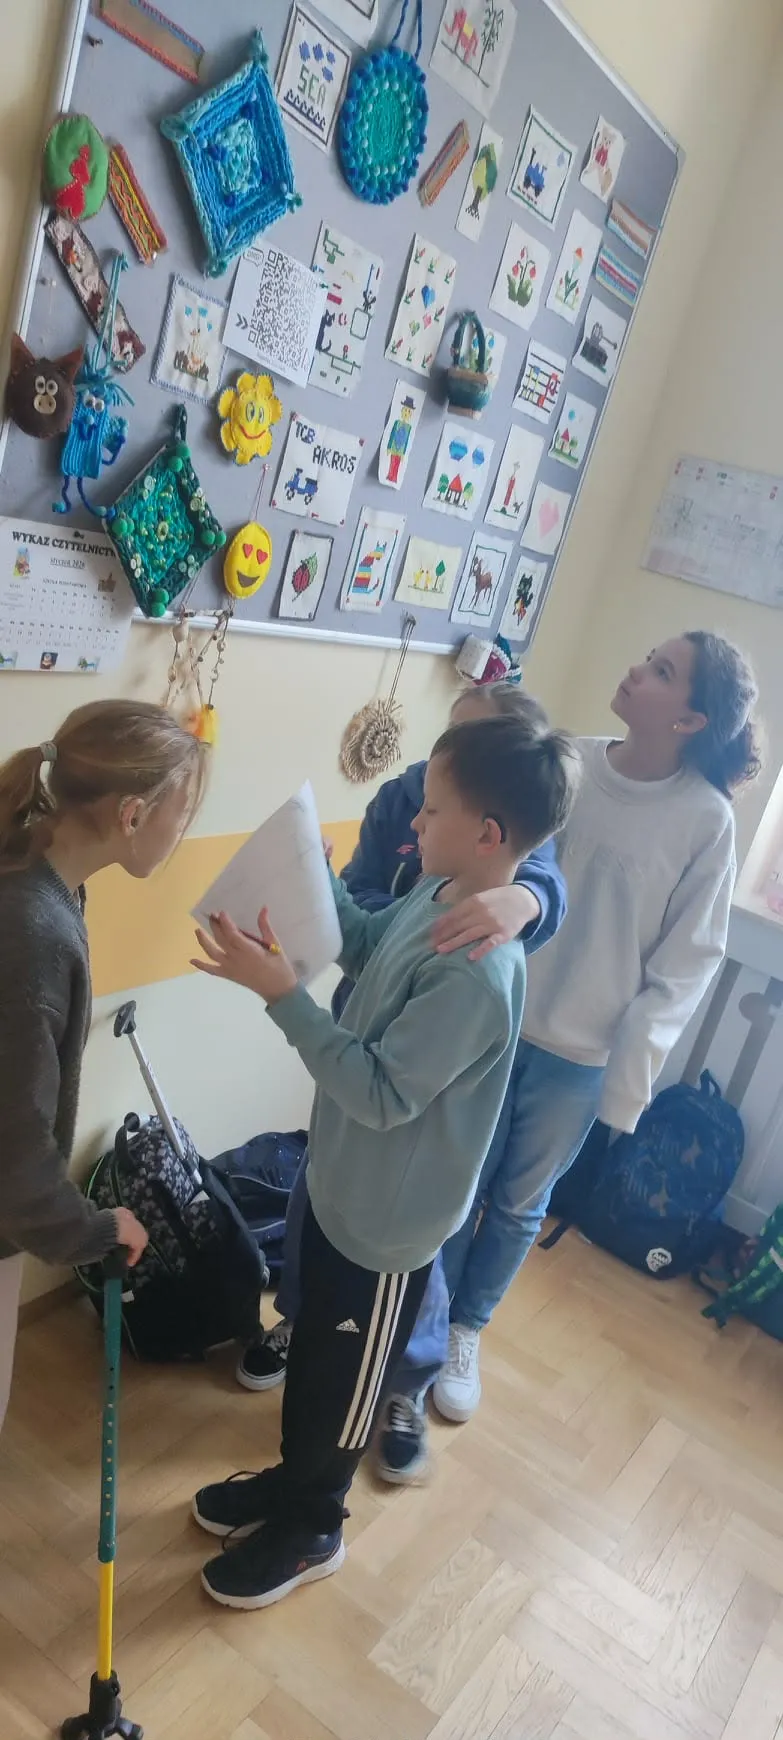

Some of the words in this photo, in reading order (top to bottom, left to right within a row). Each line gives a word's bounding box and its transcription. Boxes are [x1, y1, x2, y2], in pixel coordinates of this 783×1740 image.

[298, 64, 326, 109] SEA
[313, 446, 356, 473] AKROS
[12, 531, 50, 547] WYKAZ
